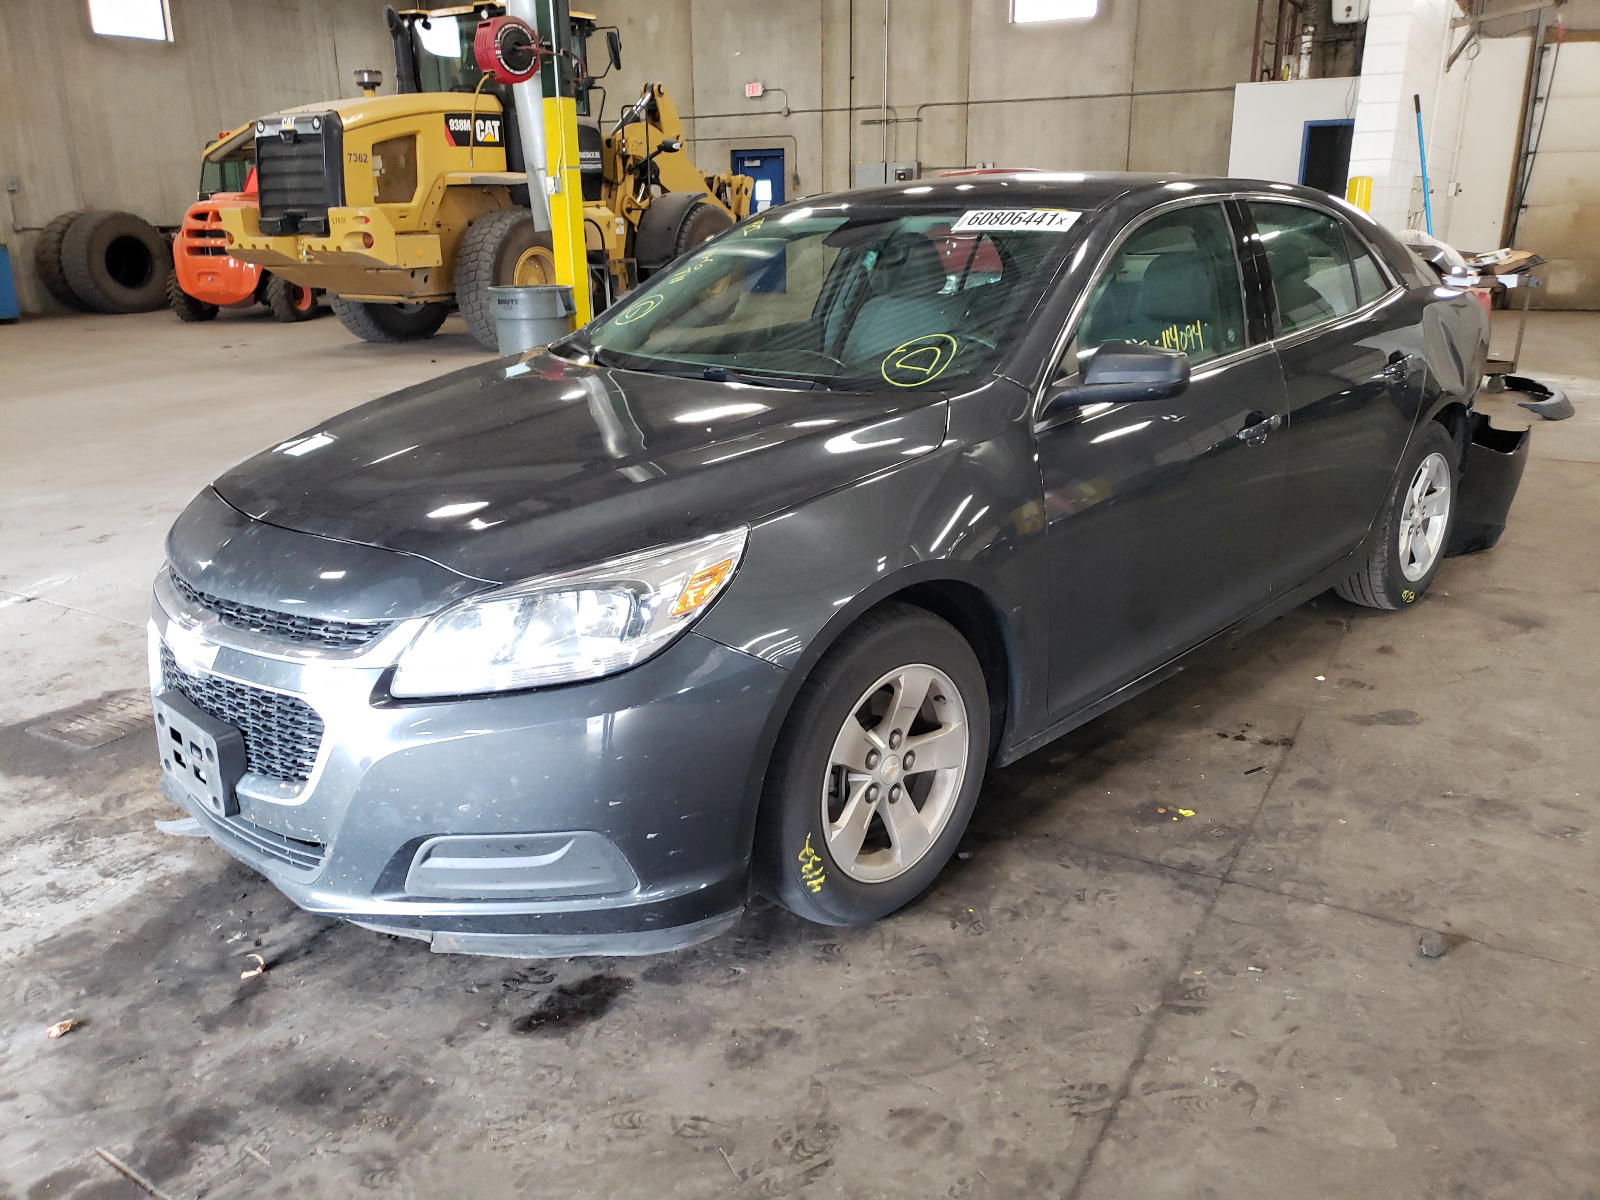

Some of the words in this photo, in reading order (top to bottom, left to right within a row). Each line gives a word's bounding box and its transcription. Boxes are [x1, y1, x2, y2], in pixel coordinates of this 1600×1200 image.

[449, 118, 471, 131] 938M
[475, 119, 500, 142] CAT
[347, 152, 369, 163] 7362
